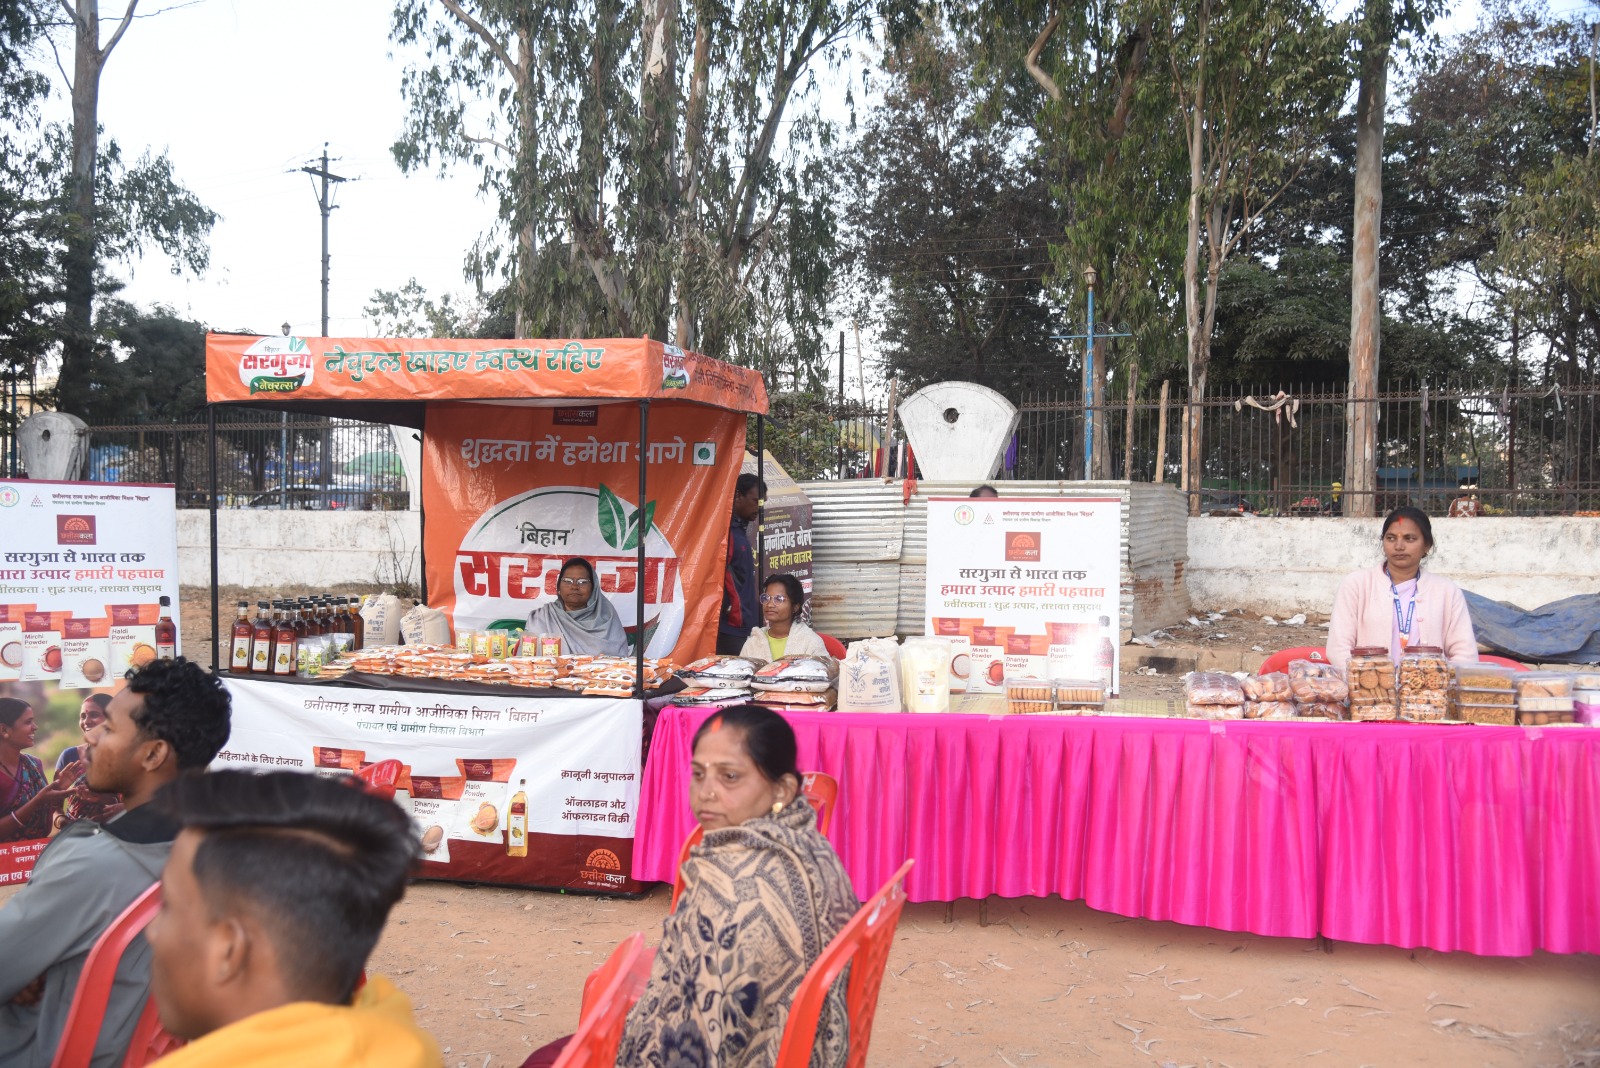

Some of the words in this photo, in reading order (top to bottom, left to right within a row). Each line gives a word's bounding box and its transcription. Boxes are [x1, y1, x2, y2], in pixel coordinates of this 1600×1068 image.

[243, 354, 310, 376] सरगुजा
[323, 345, 401, 382] नेचुरल
[404, 350, 471, 374] खाइए
[473, 348, 542, 372] स्वस्थ
[546, 341, 605, 373] रहिए
[461, 438, 531, 468] शुद्धता
[536, 434, 562, 462] में
[562, 436, 629, 466] हमेशा
[5, 552, 59, 566] सरगुजा
[63, 549, 76, 563] से
[80, 552, 116, 563] भारत
[120, 552, 145, 563] तक
[29, 569, 71, 580] उत्पाद
[74, 565, 113, 581] हमारी
[117, 569, 165, 580] पहचान
[959, 568, 1006, 583] सरगुजा
[1009, 565, 1022, 580] से
[1026, 569, 1059, 580] भारत
[1062, 570, 1087, 580] तक
[132, 585, 162, 595] समुदाय
[940, 585, 976, 596] हमारा
[979, 585, 1015, 596] उत्पाद
[1019, 582, 1055, 597] हमारी
[1059, 587, 1106, 598] पहचान
[303, 695, 349, 716] छत्तीसगढ़
[353, 701, 375, 714] राज्य
[379, 701, 411, 717] ग्रामीण
[415, 702, 467, 720] आजीविका
[471, 706, 500, 721] मिशन
[356, 719, 384, 731] पंचायत
[386, 720, 398, 732] एवं
[400, 722, 426, 734] ग्रामीण
[428, 723, 456, 735] विकास
[458, 724, 485, 737] विभाग
[250, 753, 259, 762] के
[260, 754, 275, 764] लिए
[275, 755, 303, 767] रोजगार
[593, 772, 635, 783] अनुपालन
[464, 790, 486, 798] Powder
[466, 782, 481, 790] Haldi
[414, 800, 440, 808] Dhaniya
[565, 796, 608, 808] ऑनलाइन
[414, 807, 437, 815] Powder
[562, 810, 606, 822] ऑफलाइन
[608, 812, 630, 824] बिक्री
[579, 868, 626, 884] छत्तीसकला
